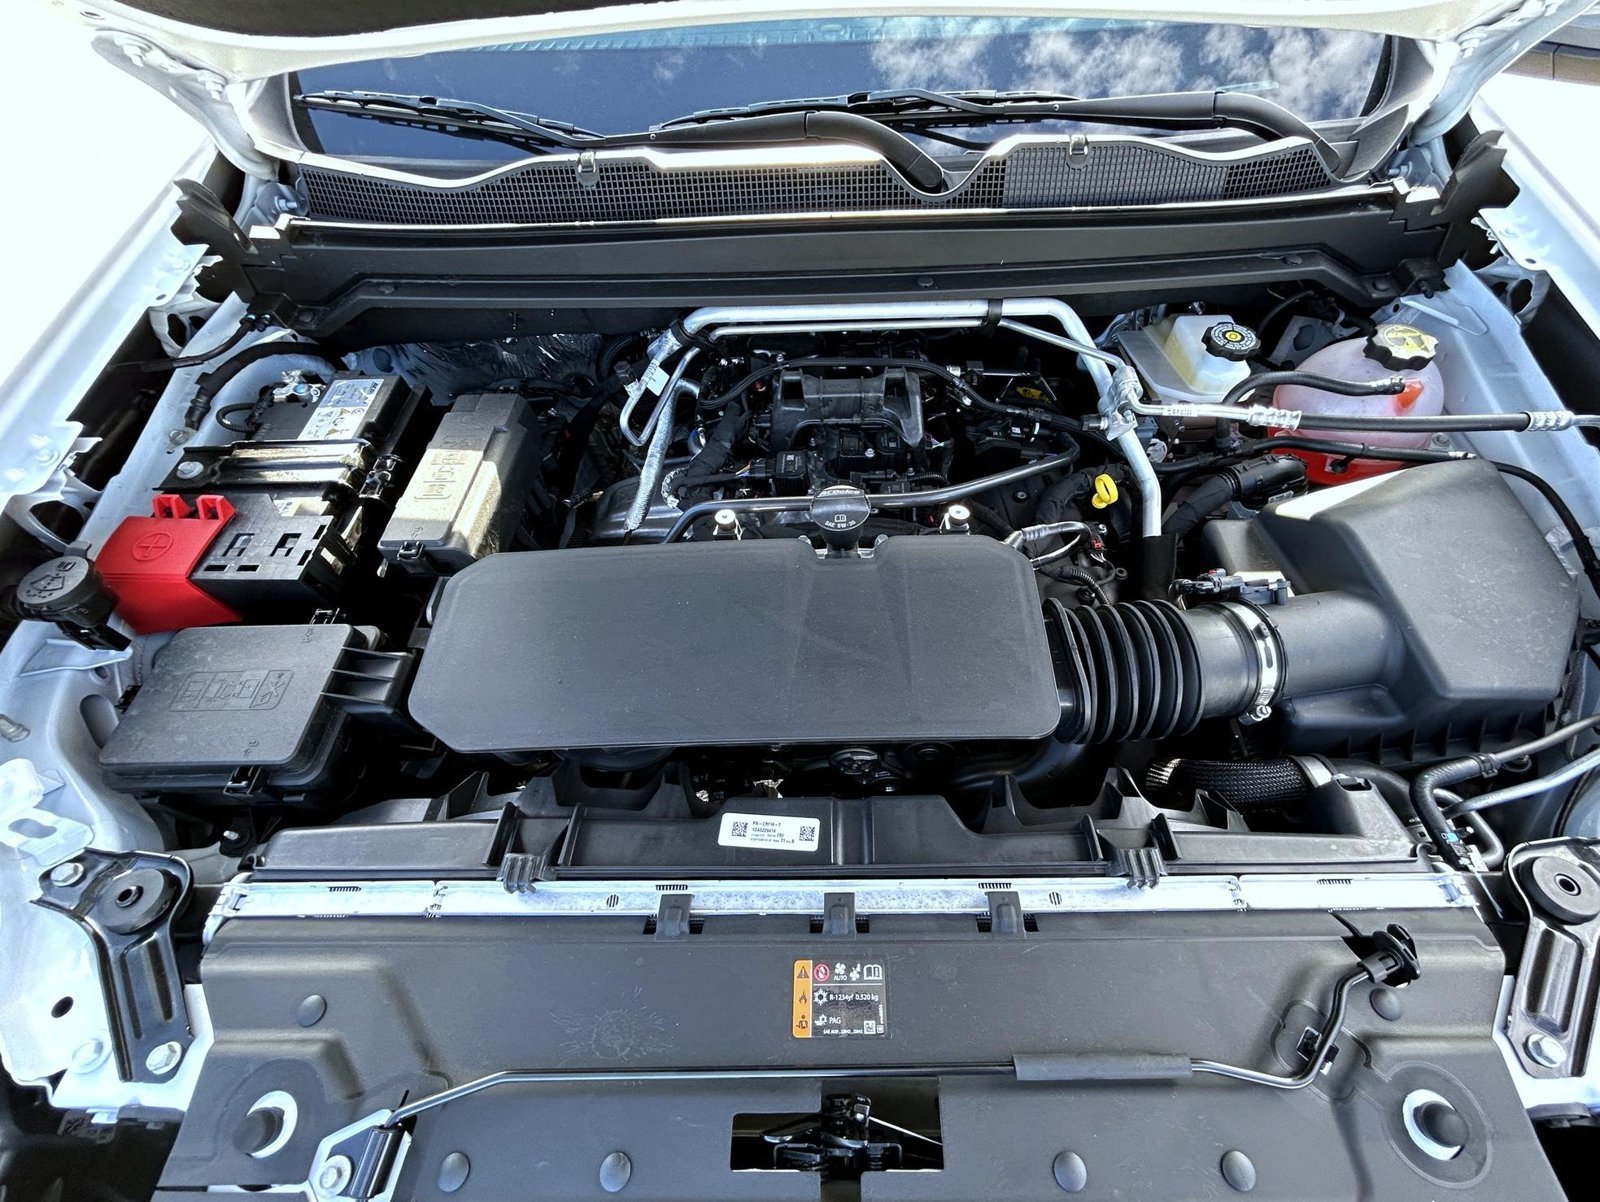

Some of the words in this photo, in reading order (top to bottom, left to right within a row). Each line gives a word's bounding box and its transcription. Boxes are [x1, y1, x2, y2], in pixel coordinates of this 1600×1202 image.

[817, 489, 861, 497] ACDelco
[824, 520, 836, 528] SAE
[837, 520, 856, 529] 5W-30
[829, 994, 854, 1002] R-1234yf
[871, 994, 878, 1002] kg
